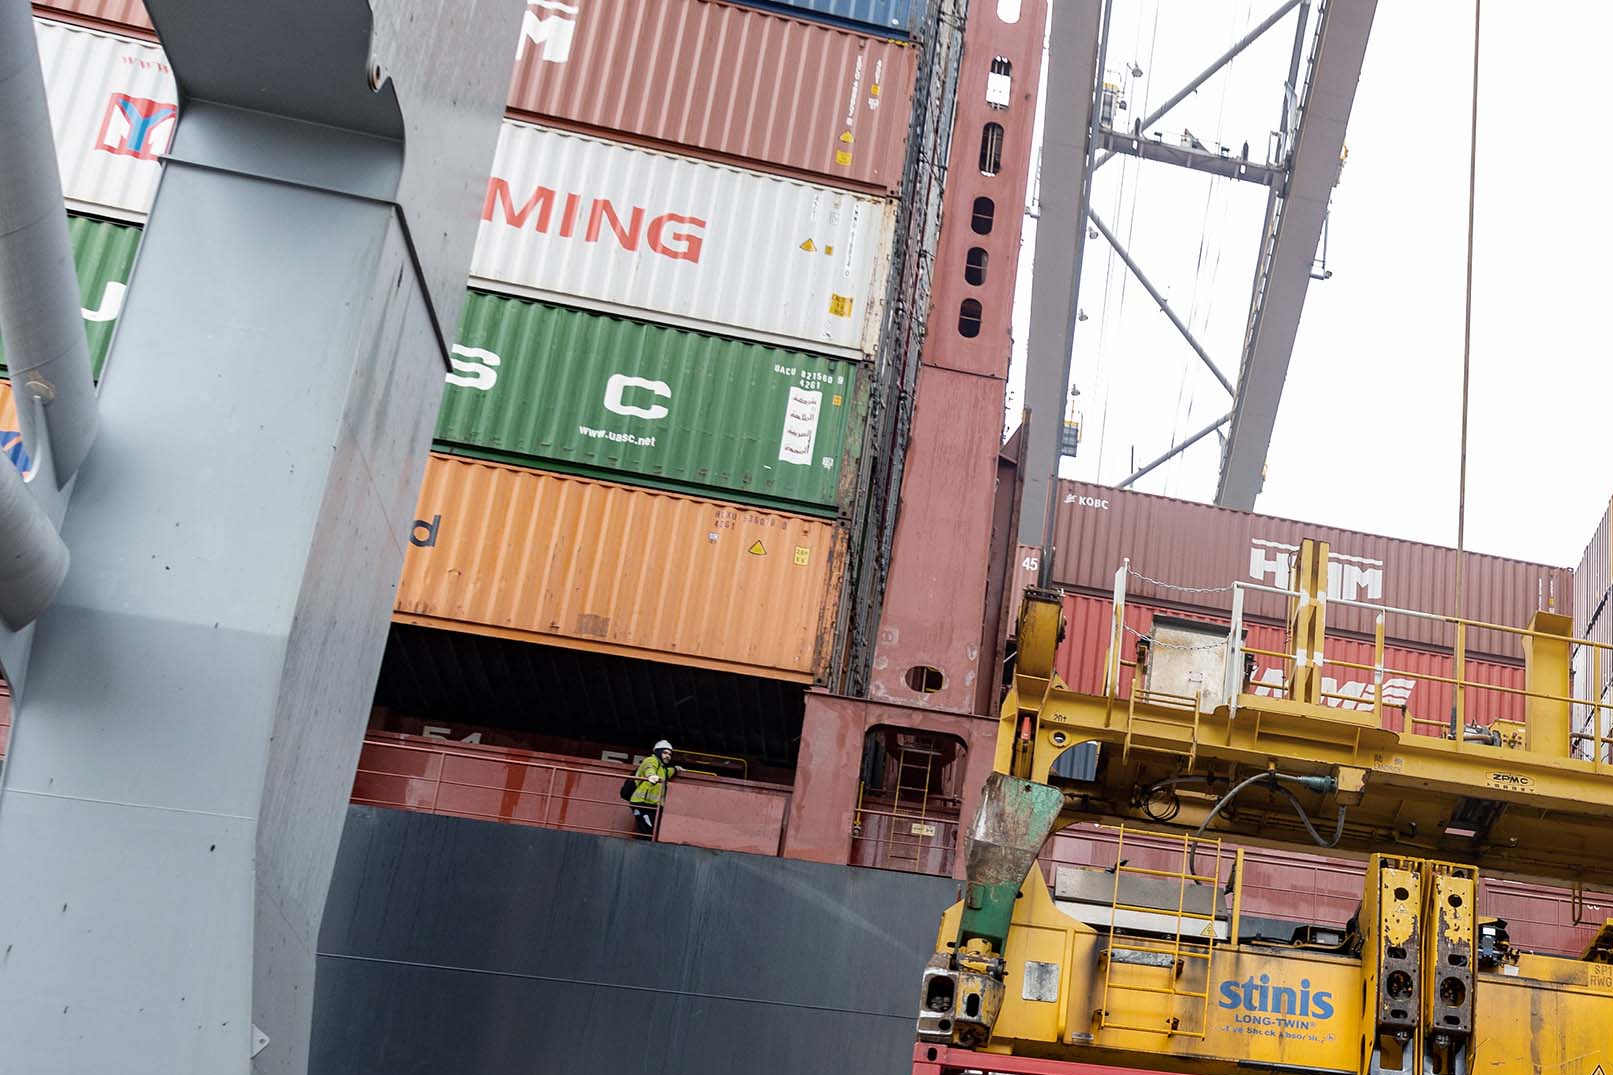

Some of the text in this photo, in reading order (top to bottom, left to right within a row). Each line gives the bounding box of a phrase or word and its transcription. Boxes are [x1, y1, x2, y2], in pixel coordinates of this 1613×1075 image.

[483, 176, 707, 264] MING
[774, 364, 796, 376] UACU
[579, 425, 656, 447] www.uasc.net
[1078, 495, 1109, 510] KOBC
[1022, 557, 1039, 571] 45
[1492, 773, 1529, 785] ZPMC
[1218, 973, 1335, 1020] stinis
